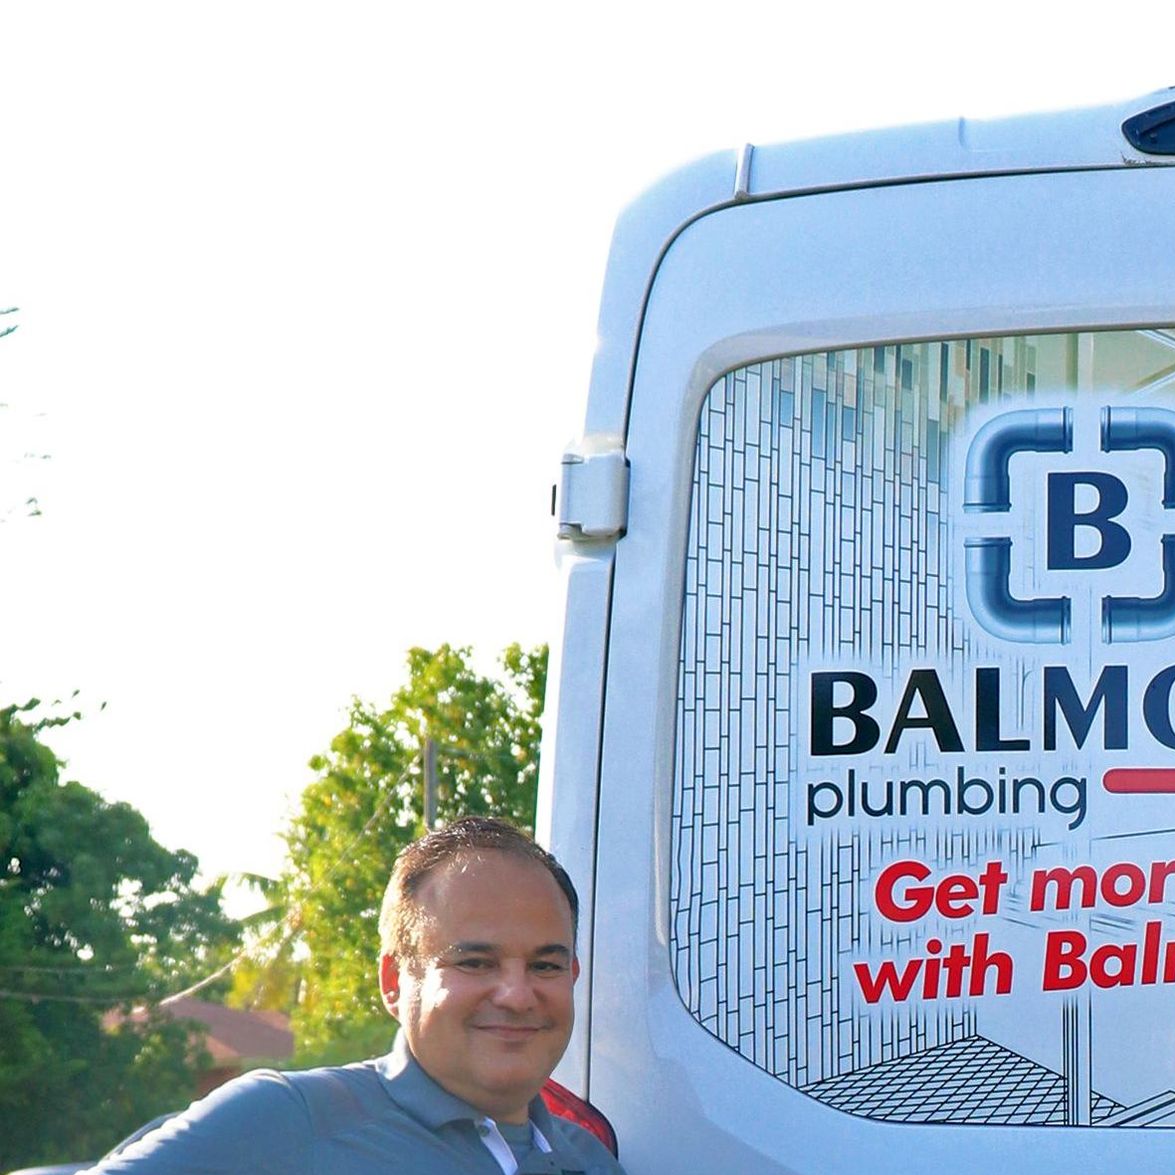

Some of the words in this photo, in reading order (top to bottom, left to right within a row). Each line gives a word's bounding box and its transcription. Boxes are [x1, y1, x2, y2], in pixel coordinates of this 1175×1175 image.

[1046, 471, 1132, 571] B
[806, 767, 1087, 830] plumbing
[874, 857, 1007, 923] Get
[853, 931, 1013, 1004] with
